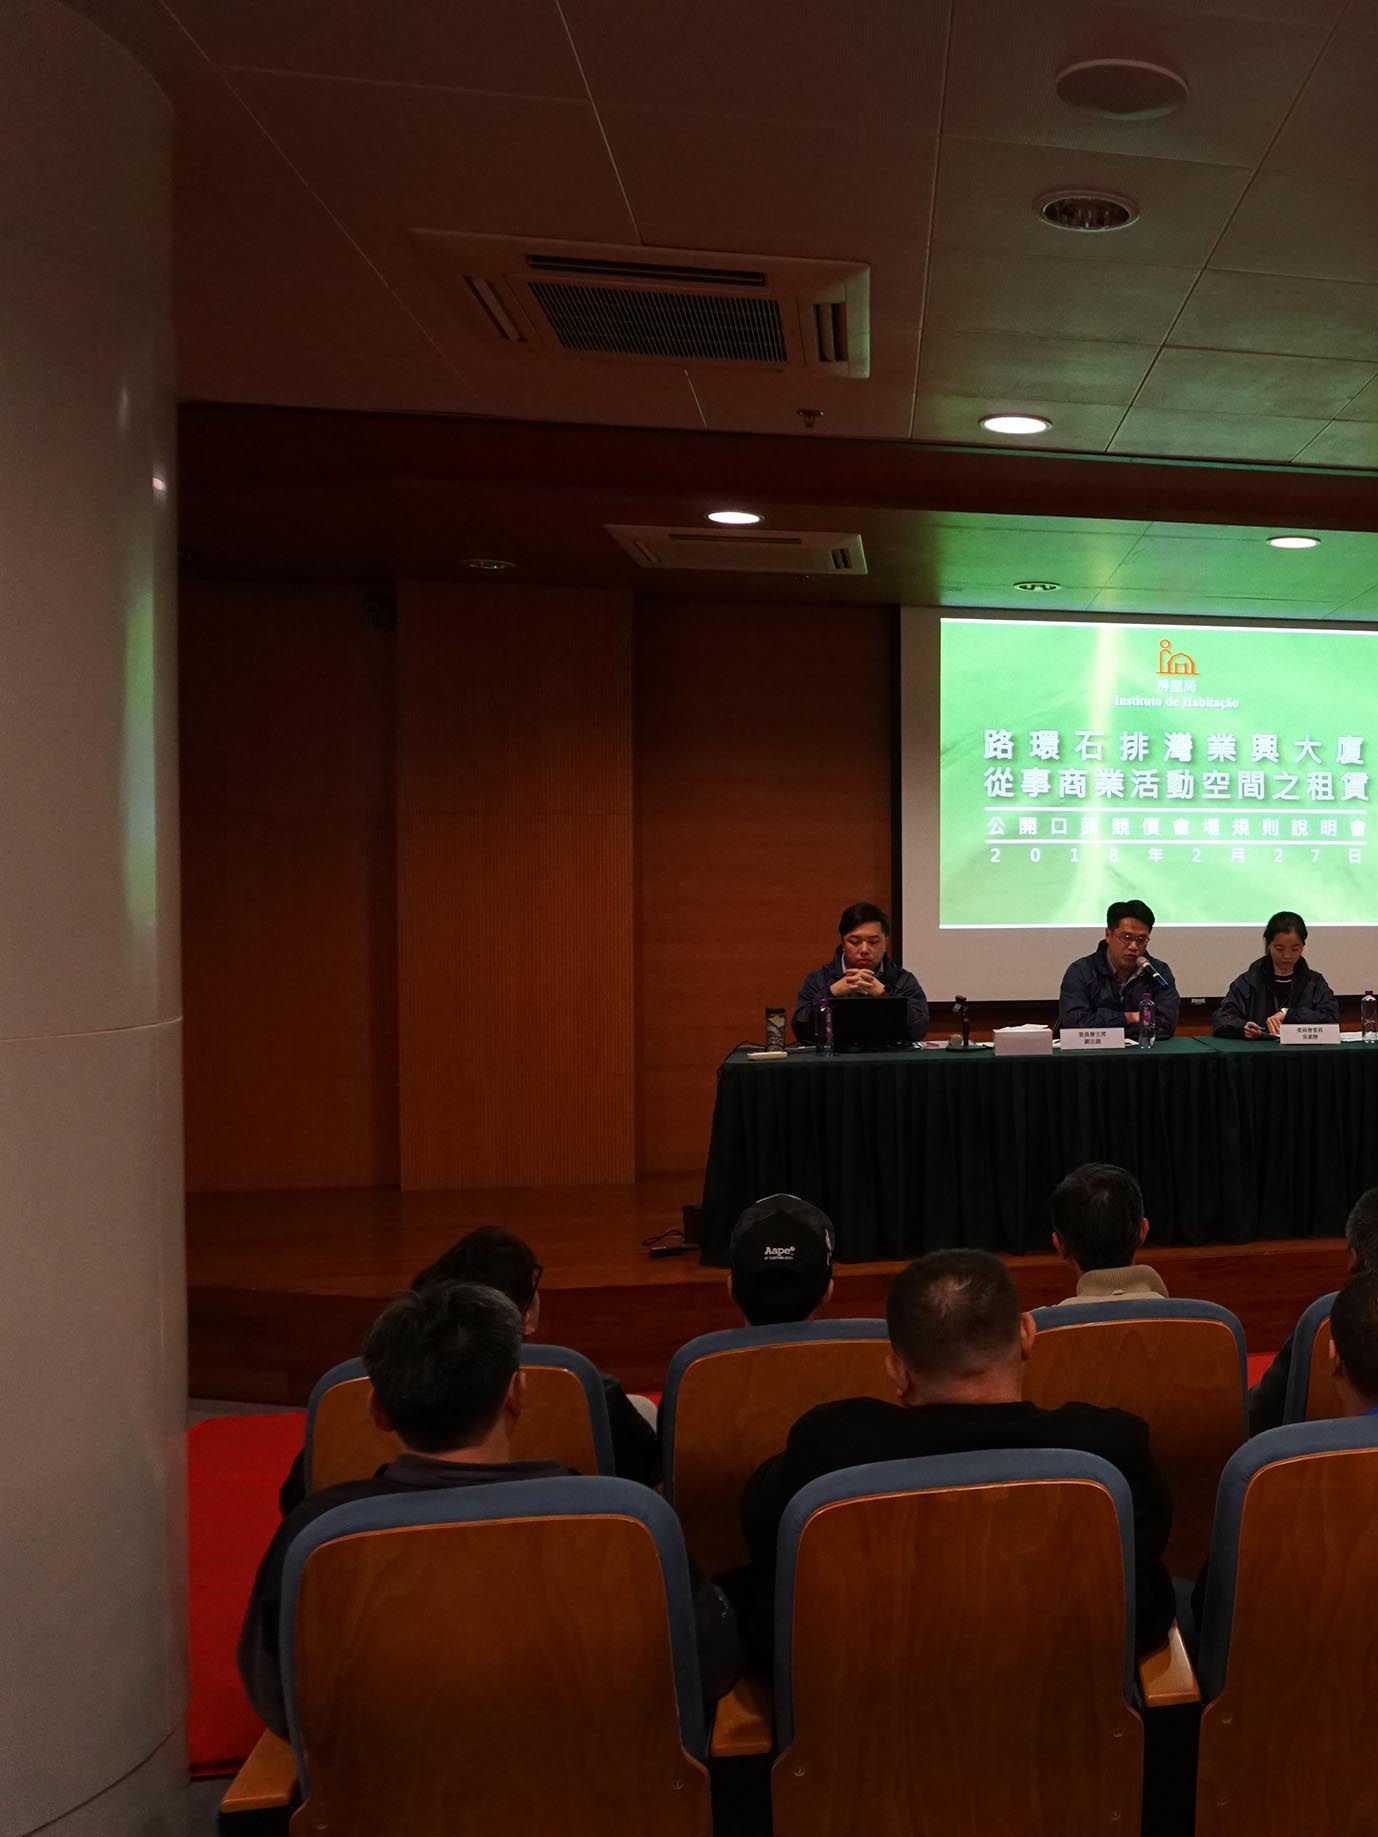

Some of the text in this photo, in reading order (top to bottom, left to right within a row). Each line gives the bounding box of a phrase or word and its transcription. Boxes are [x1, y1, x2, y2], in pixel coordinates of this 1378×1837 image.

[1115, 695, 1239, 710] Instituto de Habitação
